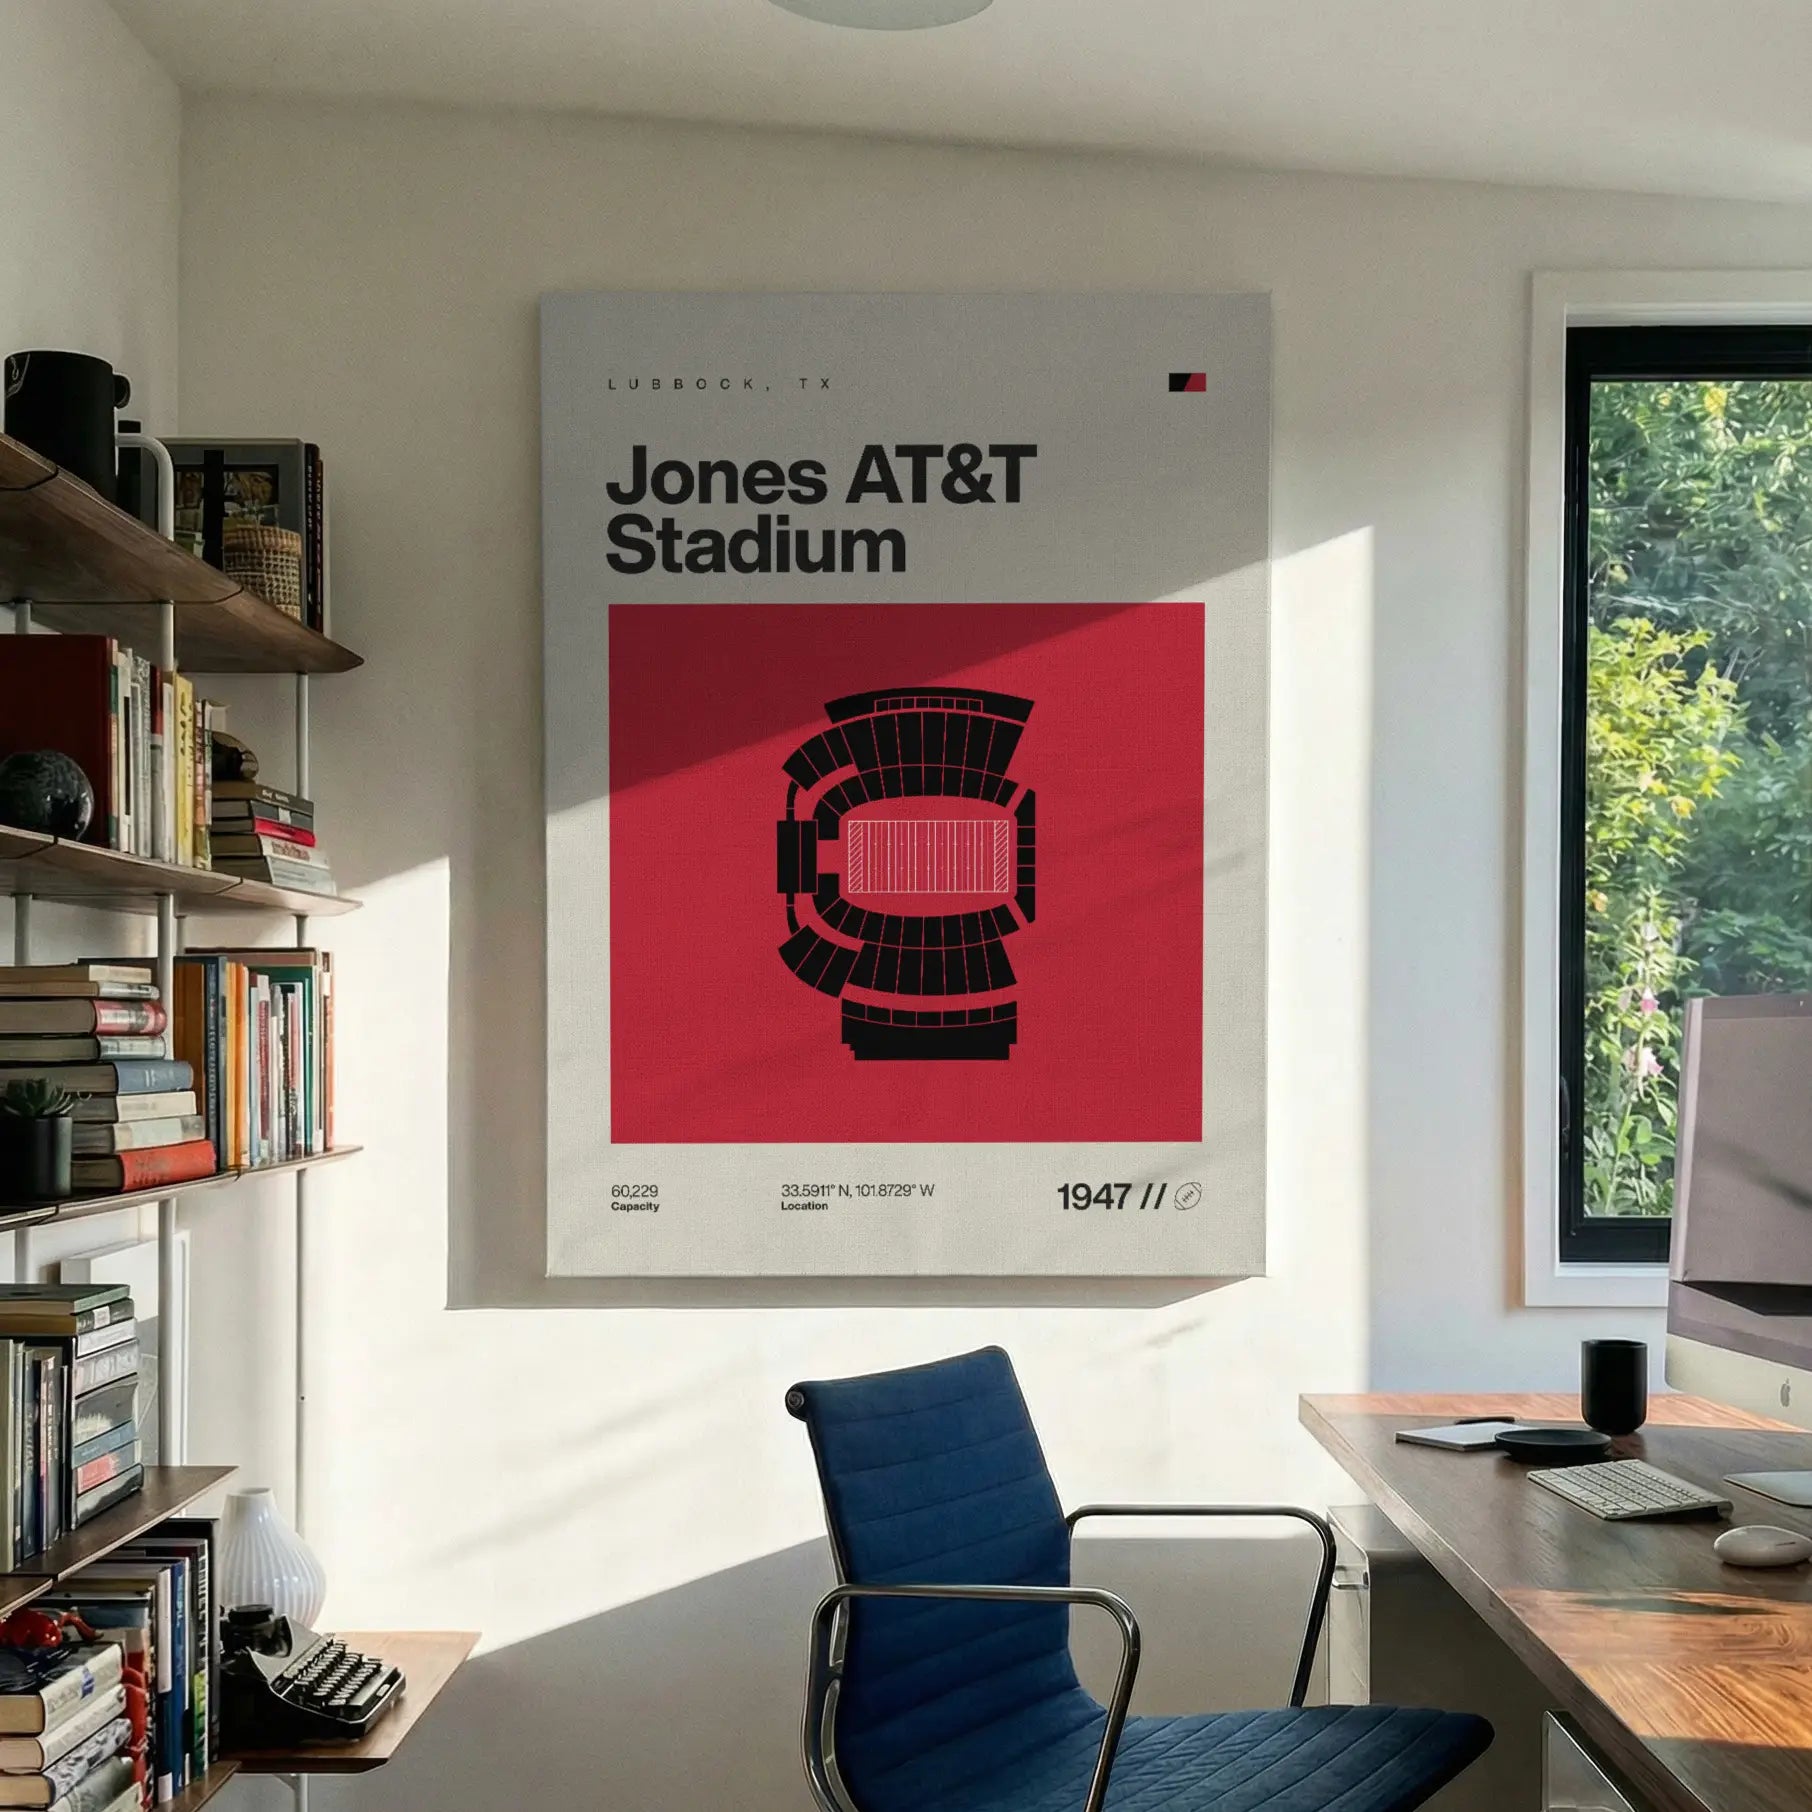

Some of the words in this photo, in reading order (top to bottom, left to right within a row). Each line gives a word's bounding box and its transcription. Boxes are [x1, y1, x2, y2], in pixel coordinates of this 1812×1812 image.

[608, 378, 769, 391] LUBBOCK,
[799, 378, 831, 390] TX
[606, 445, 827, 505] Jones
[846, 443, 1038, 504] AT&T
[606, 513, 905, 574] Stadium
[611, 1184, 659, 1199] 60,229
[781, 1184, 836, 1198] 33.5911°
[838, 1184, 853, 1199] N,
[855, 1183, 917, 1198] 101.8729°
[919, 1184, 935, 1197] W
[1058, 1183, 1132, 1210] 1947
[611, 1200, 661, 1214] Capacity
[780, 1200, 829, 1212] Location
